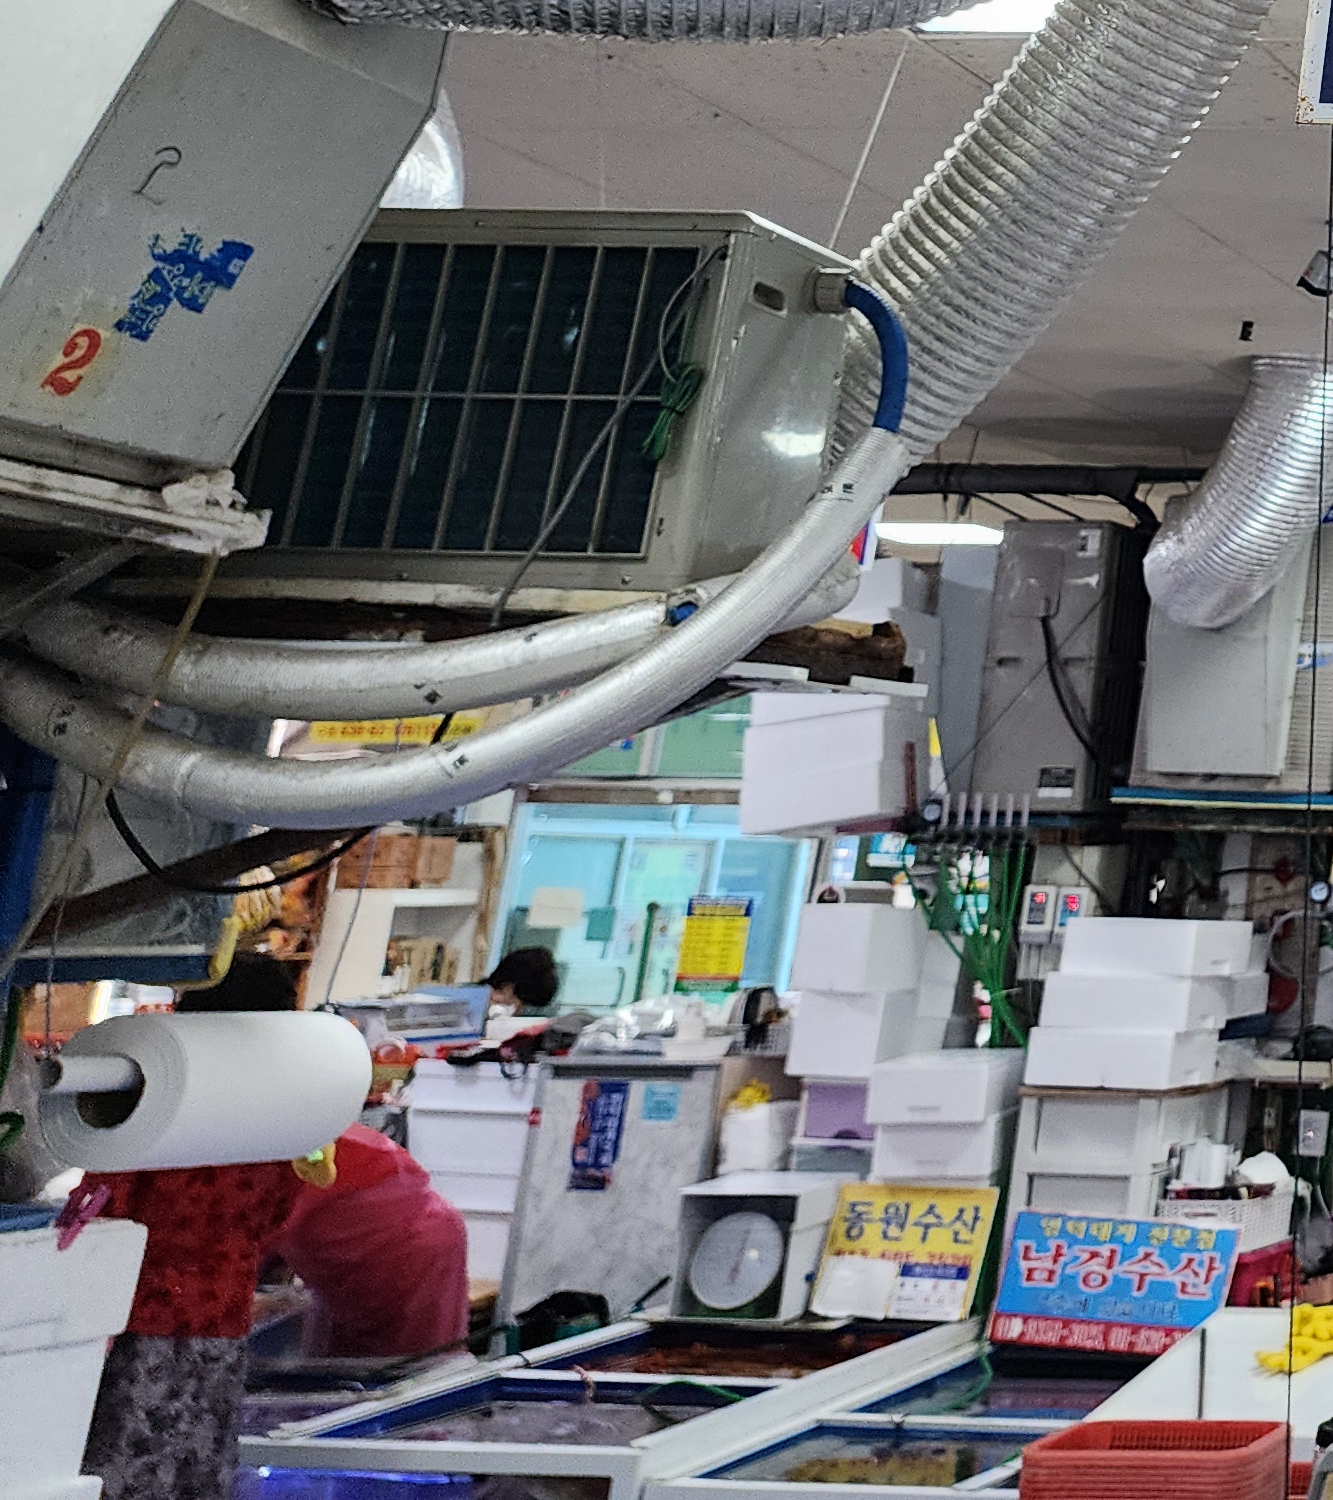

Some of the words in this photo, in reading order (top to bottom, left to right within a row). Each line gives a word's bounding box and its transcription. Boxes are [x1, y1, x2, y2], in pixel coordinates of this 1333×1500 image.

[39, 327, 102, 397] 2
[843, 1201, 983, 1245] 동원수산
[1018, 1240, 1223, 1299] 남경수산
